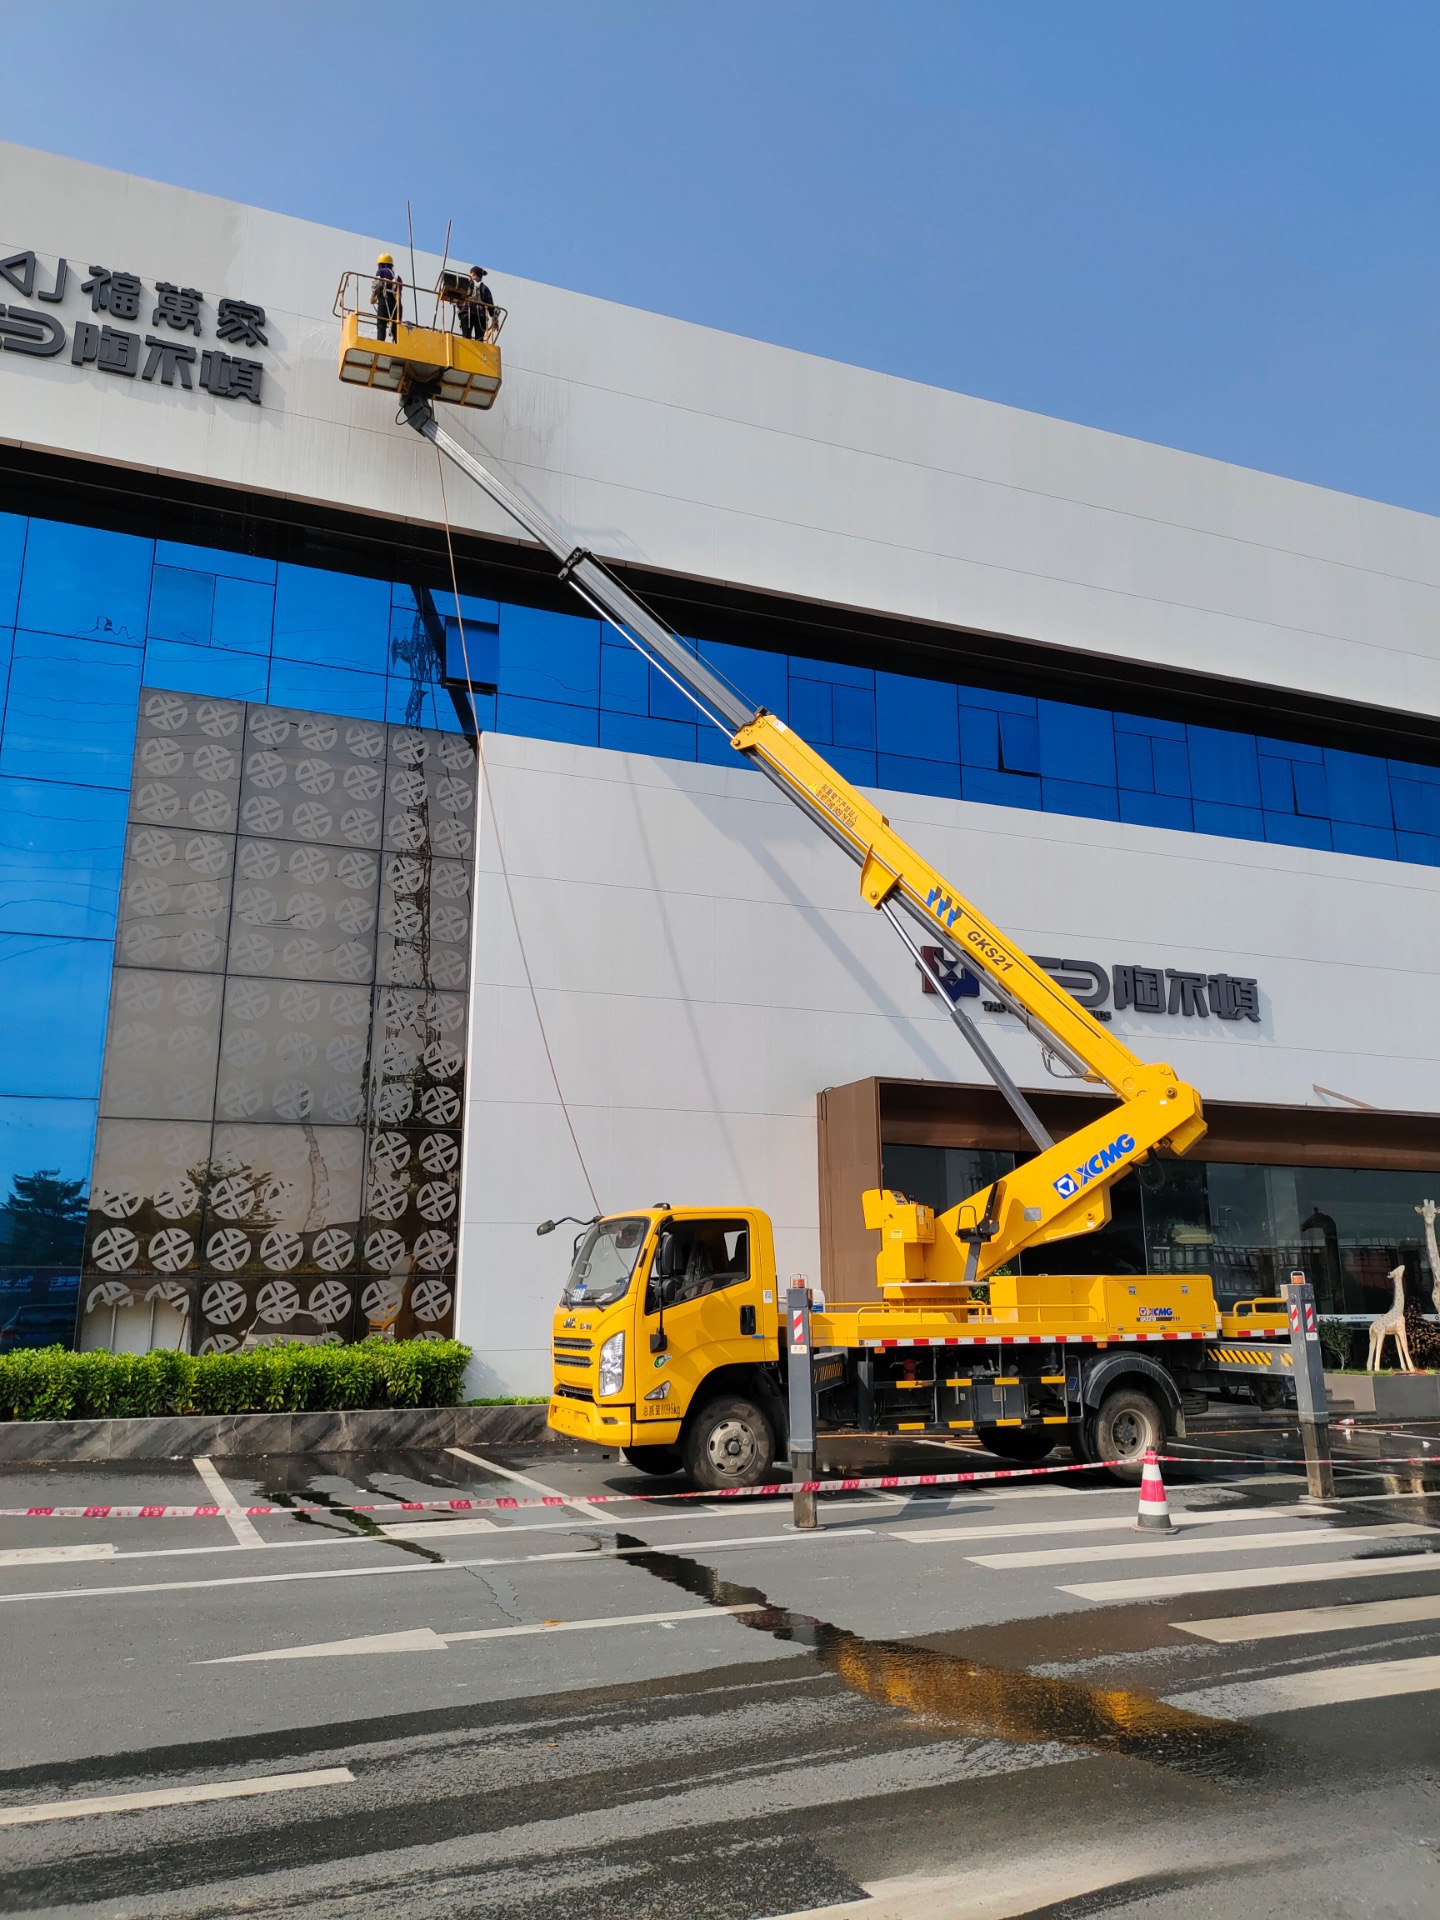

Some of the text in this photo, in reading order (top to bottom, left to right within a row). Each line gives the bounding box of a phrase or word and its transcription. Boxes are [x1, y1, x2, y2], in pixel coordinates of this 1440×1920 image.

[967, 930, 1014, 972] GKS21
[1074, 1134, 1135, 1187] XCMG
[1148, 1308, 1173, 1316] XCMG
